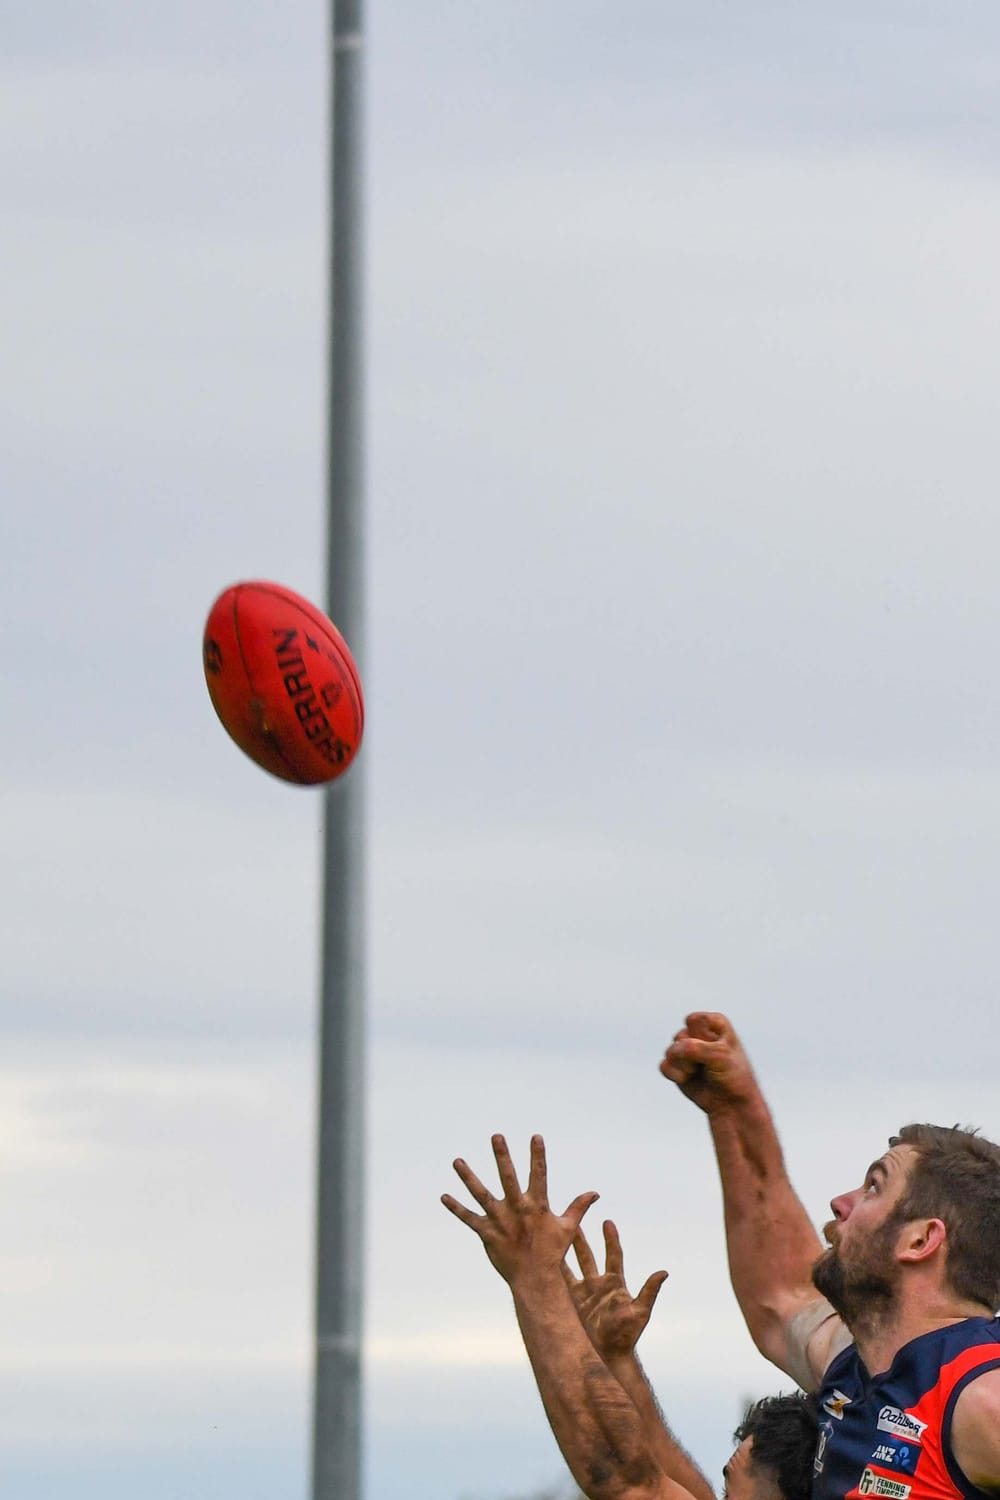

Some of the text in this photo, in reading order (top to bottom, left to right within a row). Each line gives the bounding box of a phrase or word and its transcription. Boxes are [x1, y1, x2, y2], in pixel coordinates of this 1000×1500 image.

[273, 628, 346, 764] SHERRIN
[871, 1444, 896, 1462] ANZ
[877, 1478, 906, 1494] FENNING
